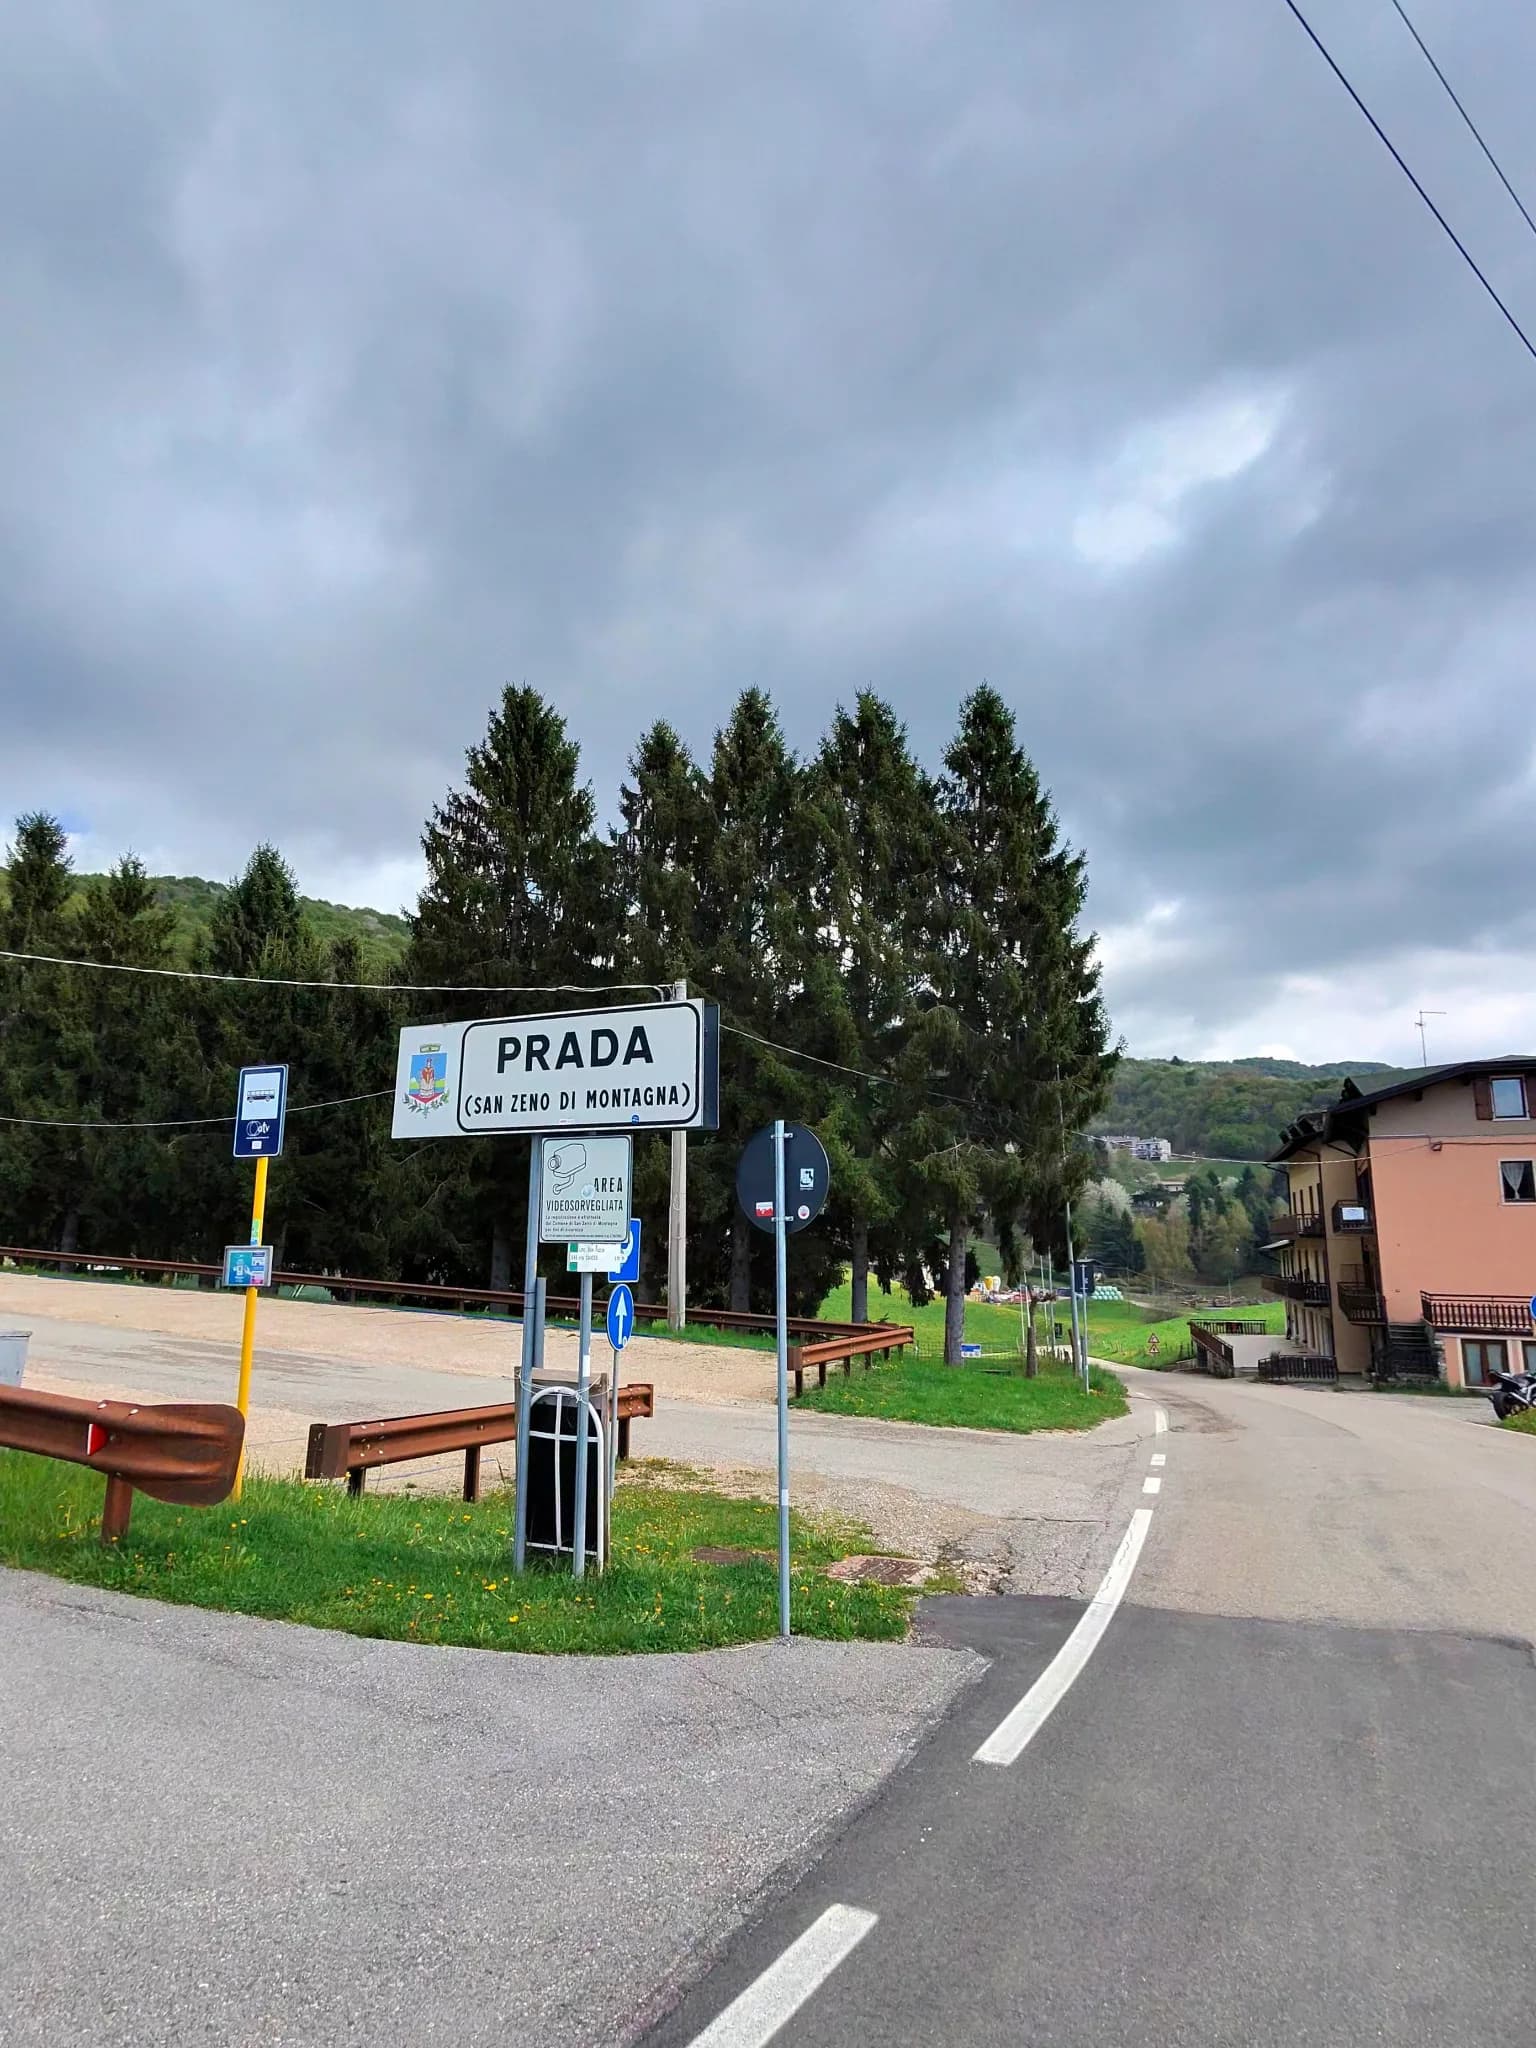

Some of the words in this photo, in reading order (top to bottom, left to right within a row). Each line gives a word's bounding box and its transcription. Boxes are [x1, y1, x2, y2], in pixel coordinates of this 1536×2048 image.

[497, 1025, 653, 1074] PRADA
[465, 1094, 503, 1117] (SAN
[511, 1092, 550, 1113] ZENO
[560, 1091, 576, 1110] DI
[586, 1082, 691, 1109] MONTAGNA)
[594, 1177, 623, 1193] AREA
[546, 1199, 624, 1212] VIDEOSORVEGLIATA
